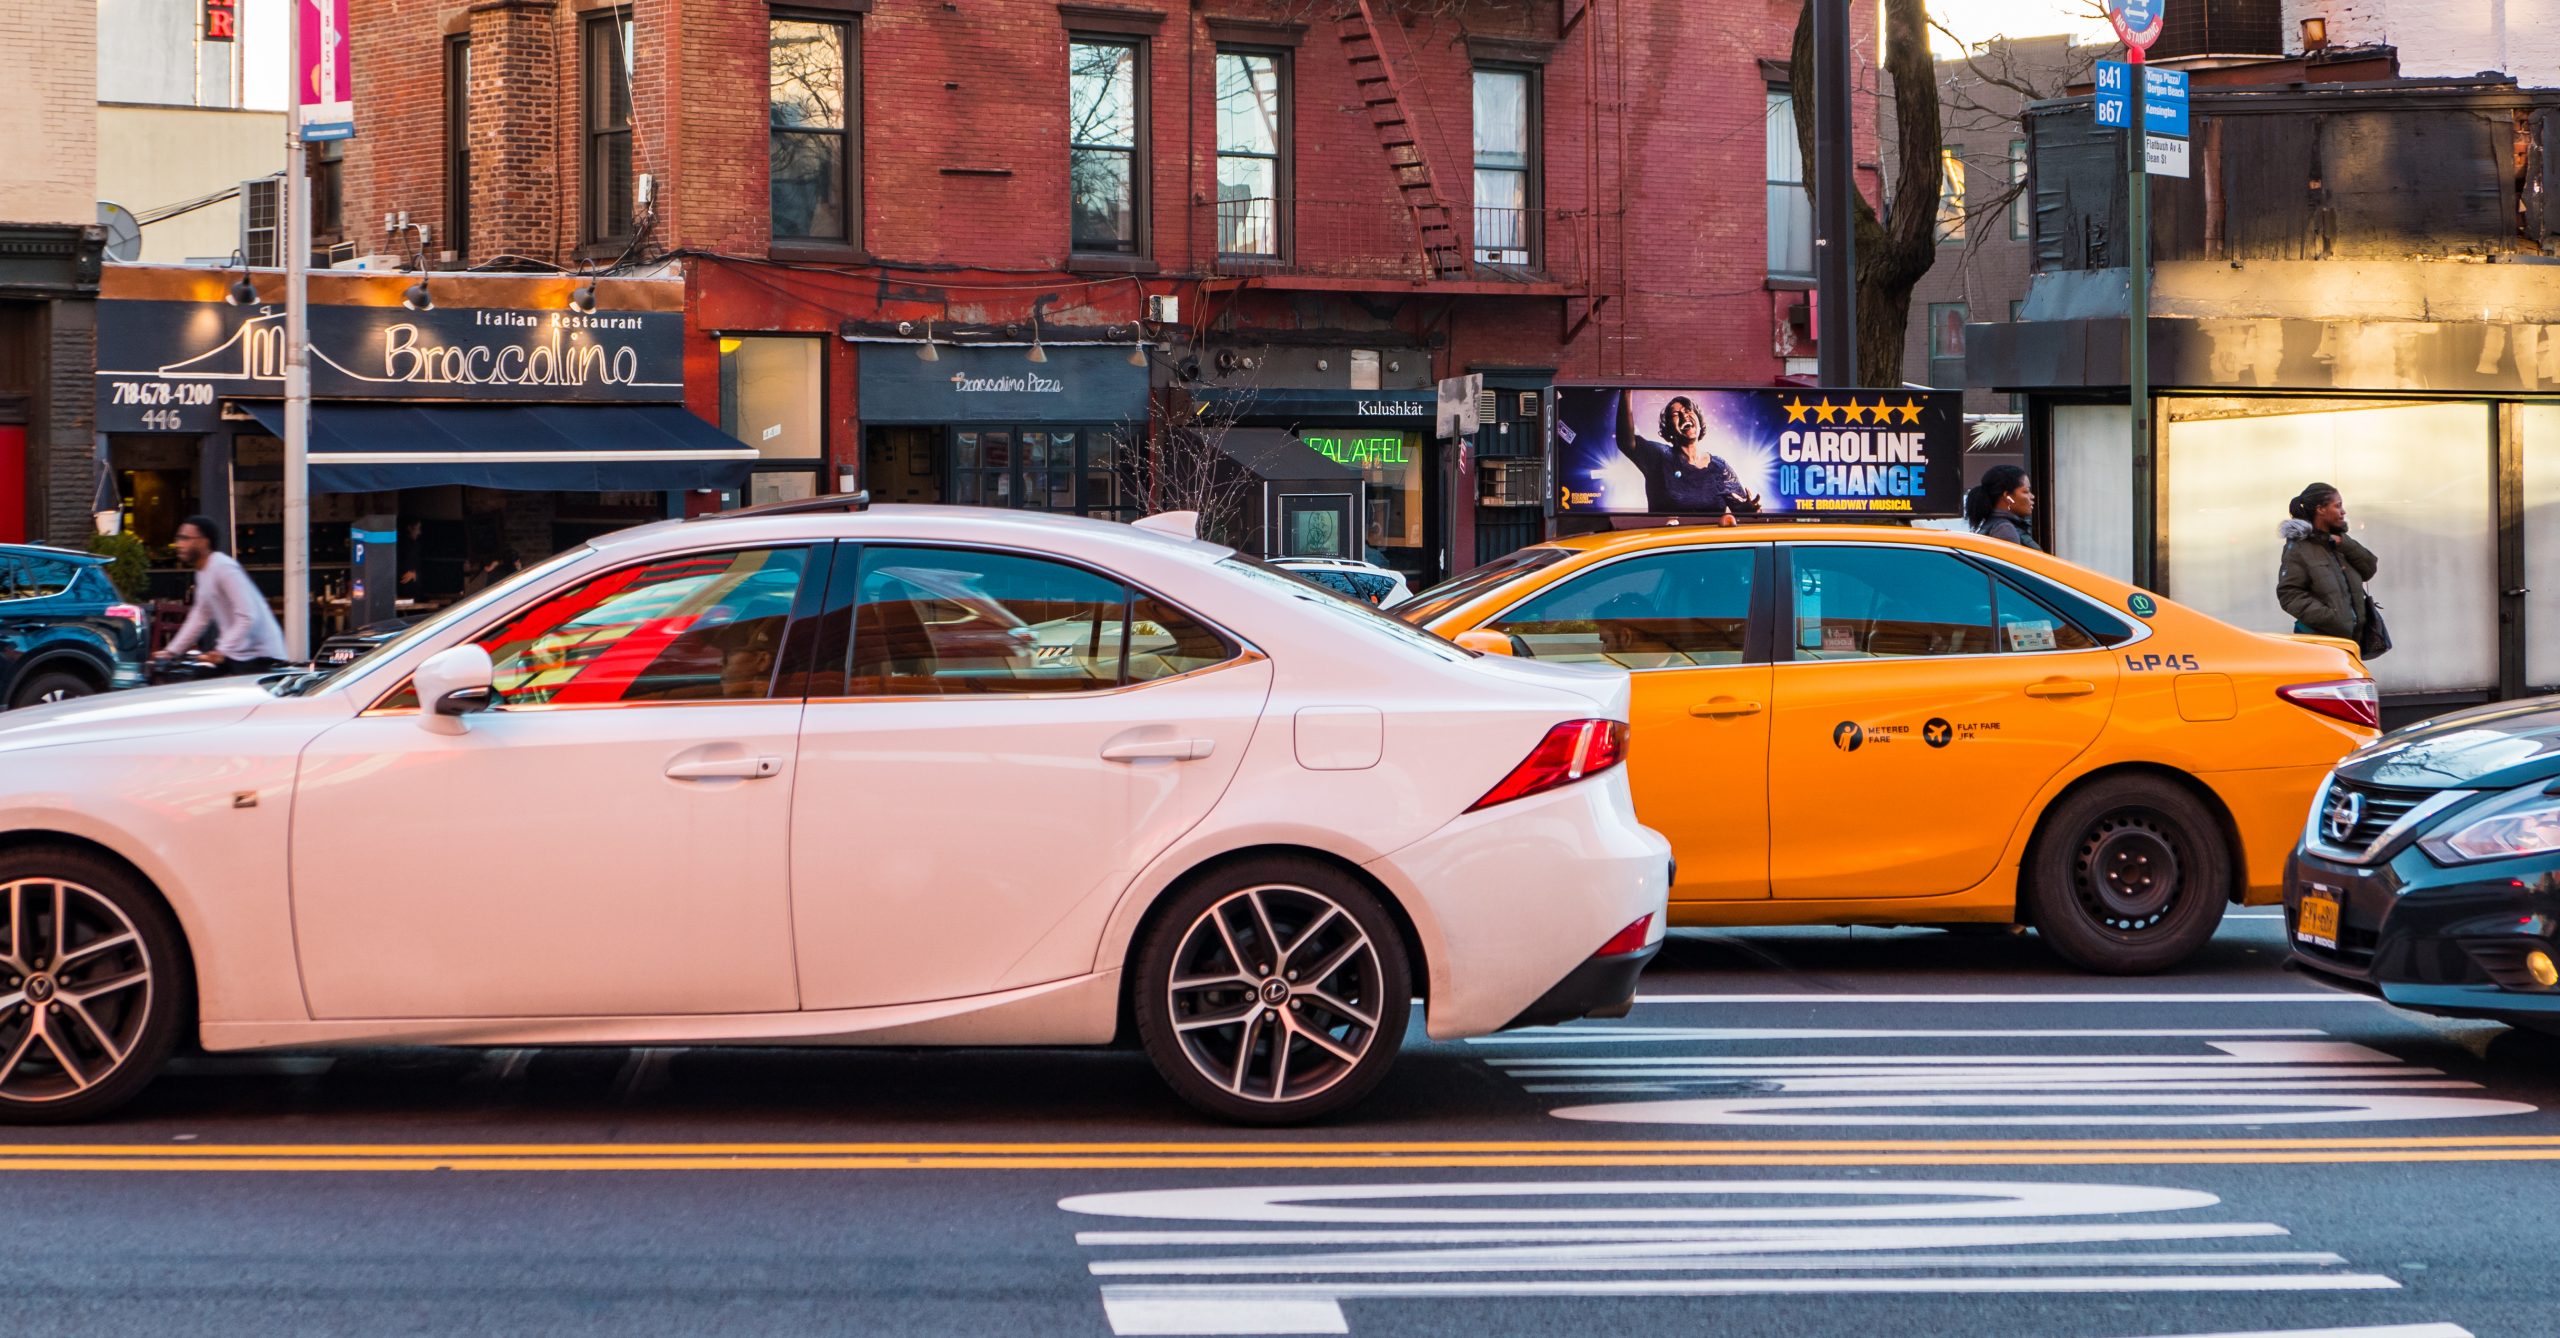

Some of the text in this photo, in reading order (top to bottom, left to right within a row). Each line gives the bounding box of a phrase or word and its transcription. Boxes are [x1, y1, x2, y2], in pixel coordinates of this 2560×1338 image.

[2114, 13, 2160, 45] NO STANDING
[2099, 66, 2121, 89] B41
[2146, 71, 2163, 85] Kings
[2147, 83, 2185, 98] Bergen Beach
[2099, 100, 2123, 123] B67
[2145, 104, 2177, 118] Kensington
[2146, 138, 2182, 154] Flatbush Av &
[2146, 152, 2167, 165] Dean St
[476, 311, 643, 330] Italian Restaurant
[384, 323, 637, 386] Broccolino
[955, 371, 1064, 393] Broccolino Pizza
[112, 382, 214, 405] 718-678-4200
[1357, 401, 1424, 416] Kulushkät
[141, 410, 181, 430] 446
[1779, 431, 1929, 466] CAROLINE,
[1780, 464, 1926, 497] OR CHANGE
[1795, 499, 1913, 511] THE BROADWAY MUSICAL
[1868, 725, 1910, 734] METERED
[1957, 722, 2001, 731] FLAT FARE
[1868, 735, 1891, 743] FARE
[1958, 732, 1975, 740] JFK
